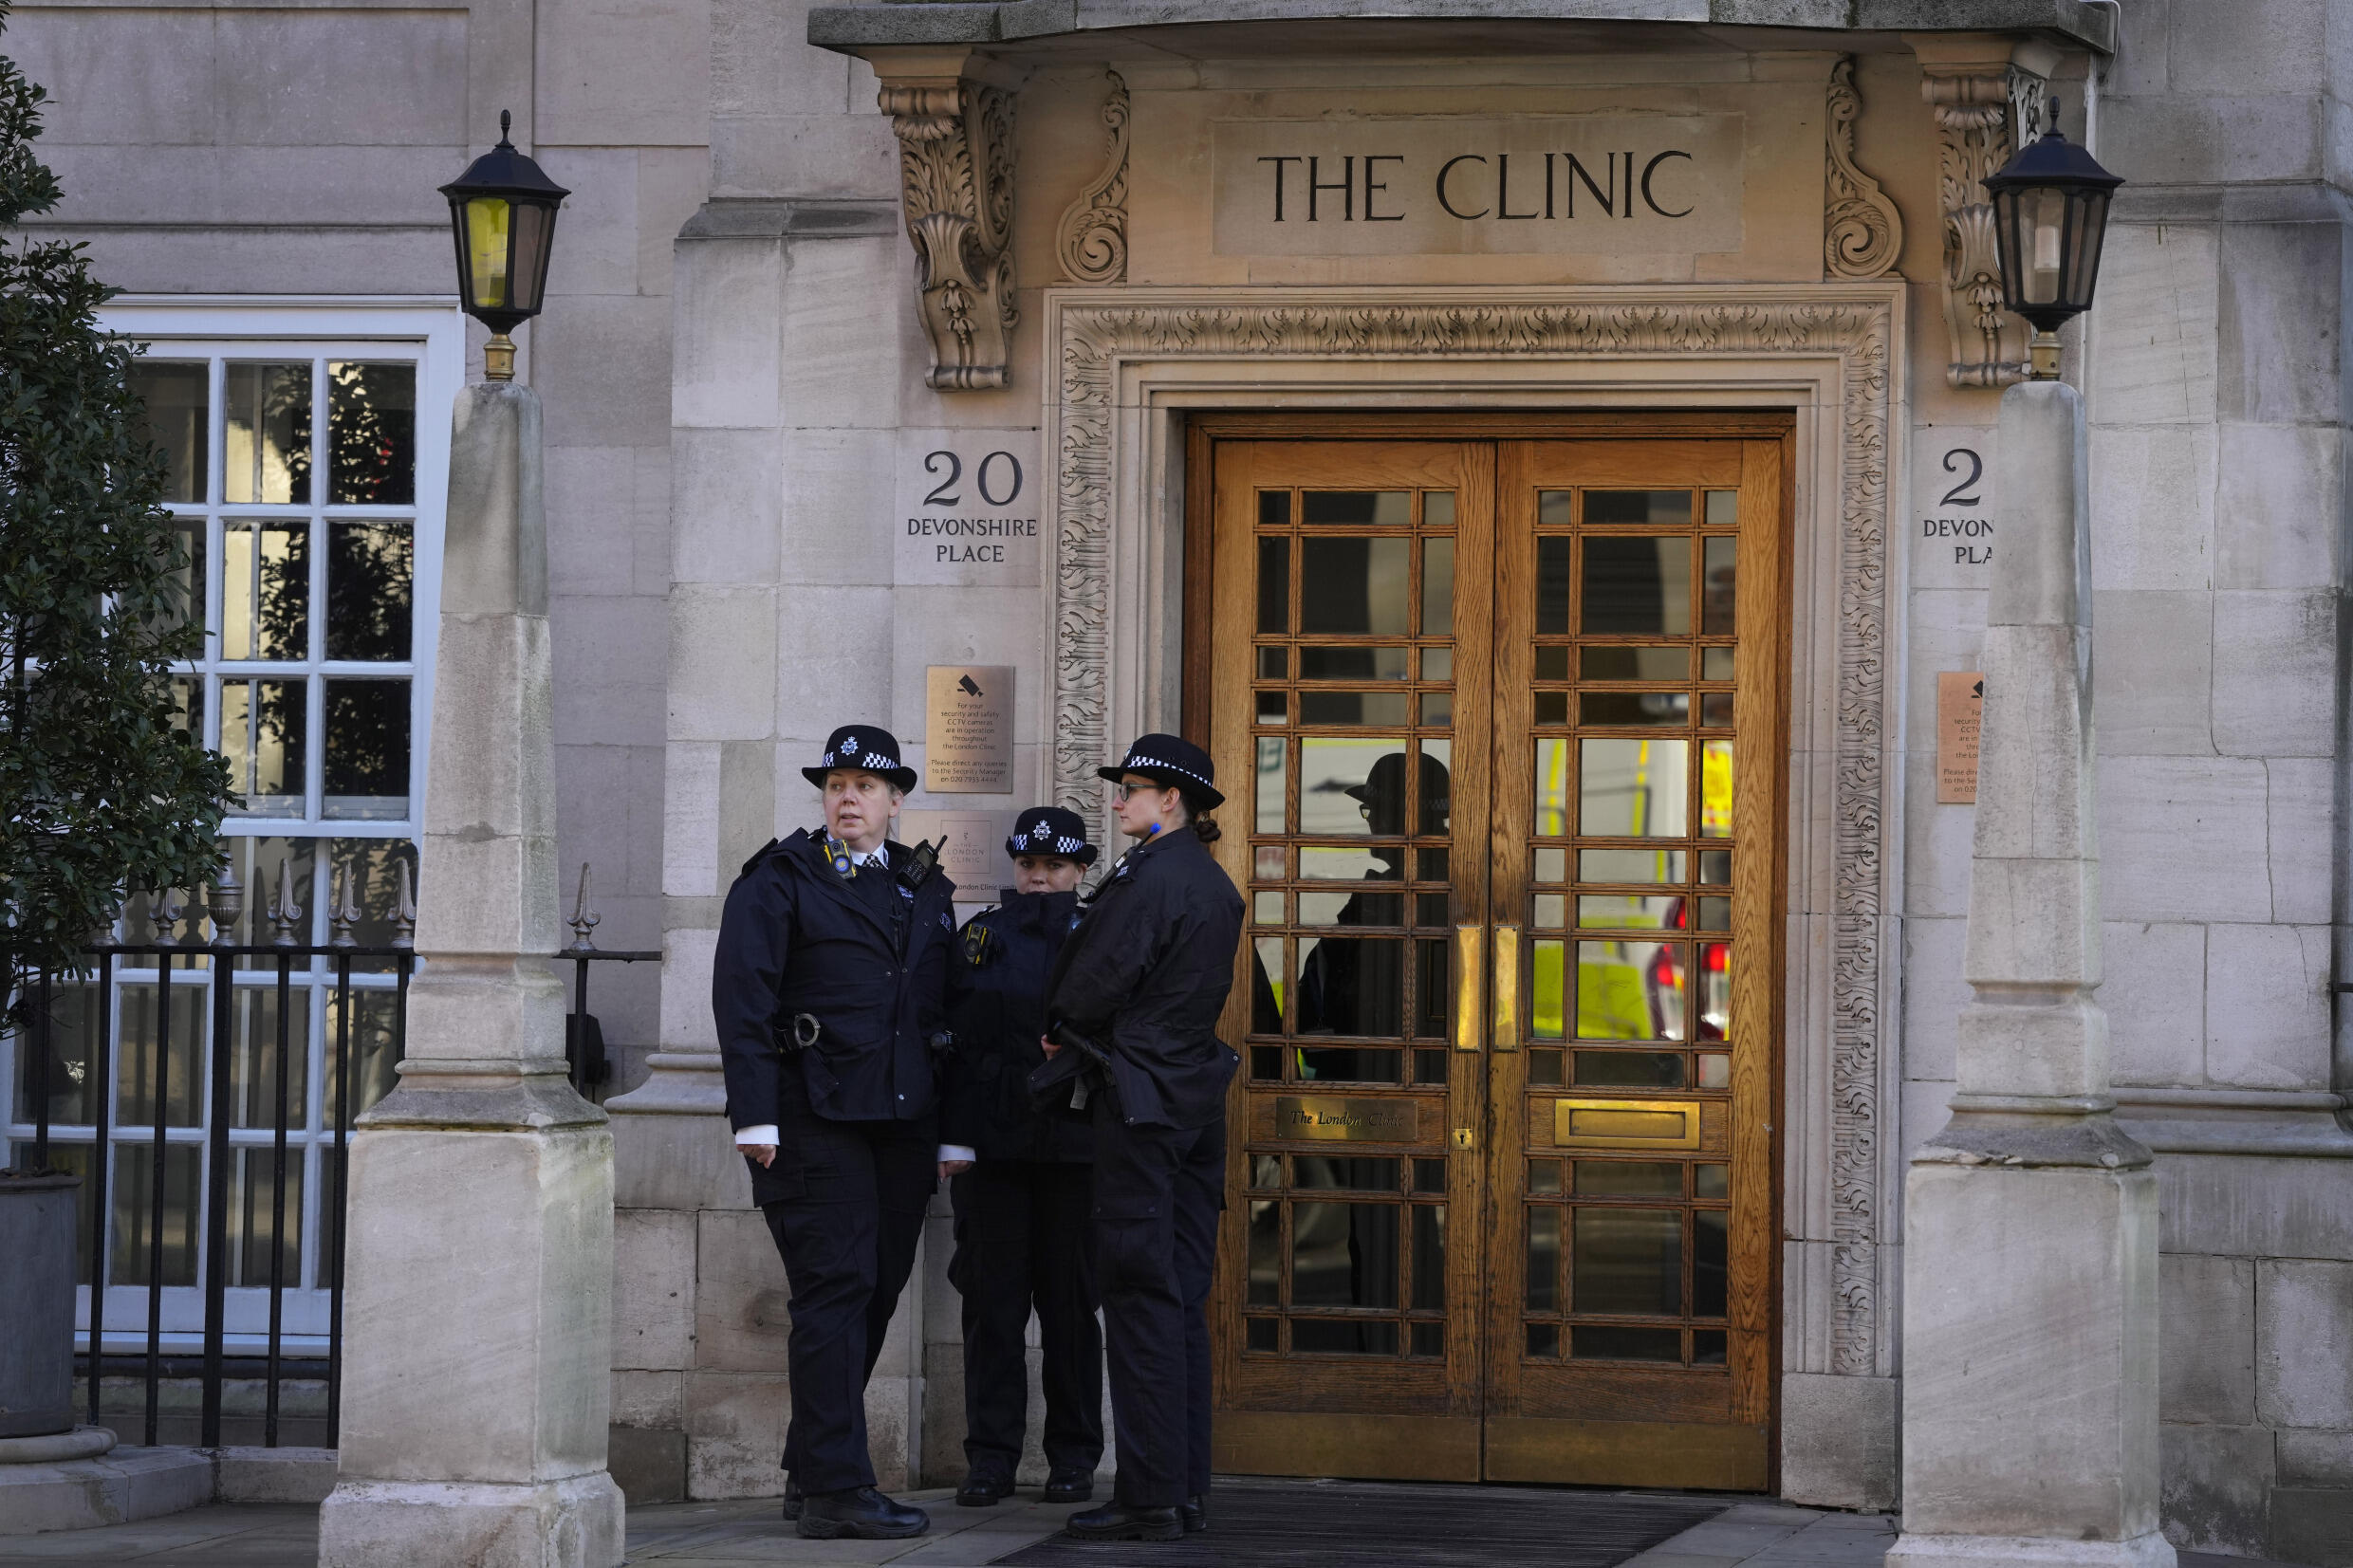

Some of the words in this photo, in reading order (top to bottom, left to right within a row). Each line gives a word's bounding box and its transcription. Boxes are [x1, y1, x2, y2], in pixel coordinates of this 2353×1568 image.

[1257, 155, 1406, 222] THE
[1436, 150, 1695, 221] CLINIC
[923, 451, 1023, 507] 20
[1939, 448, 1982, 507] 2
[908, 518, 1037, 536] DEVONSHIRE
[1923, 519, 1993, 537] DEVON
[936, 544, 1004, 562] PLACE
[1955, 546, 1992, 564] PLA
[941, 710, 966, 719] security
[1289, 1110, 1313, 1125] The
[1318, 1110, 1362, 1127] London
[1367, 1113, 1403, 1128] Clinic
